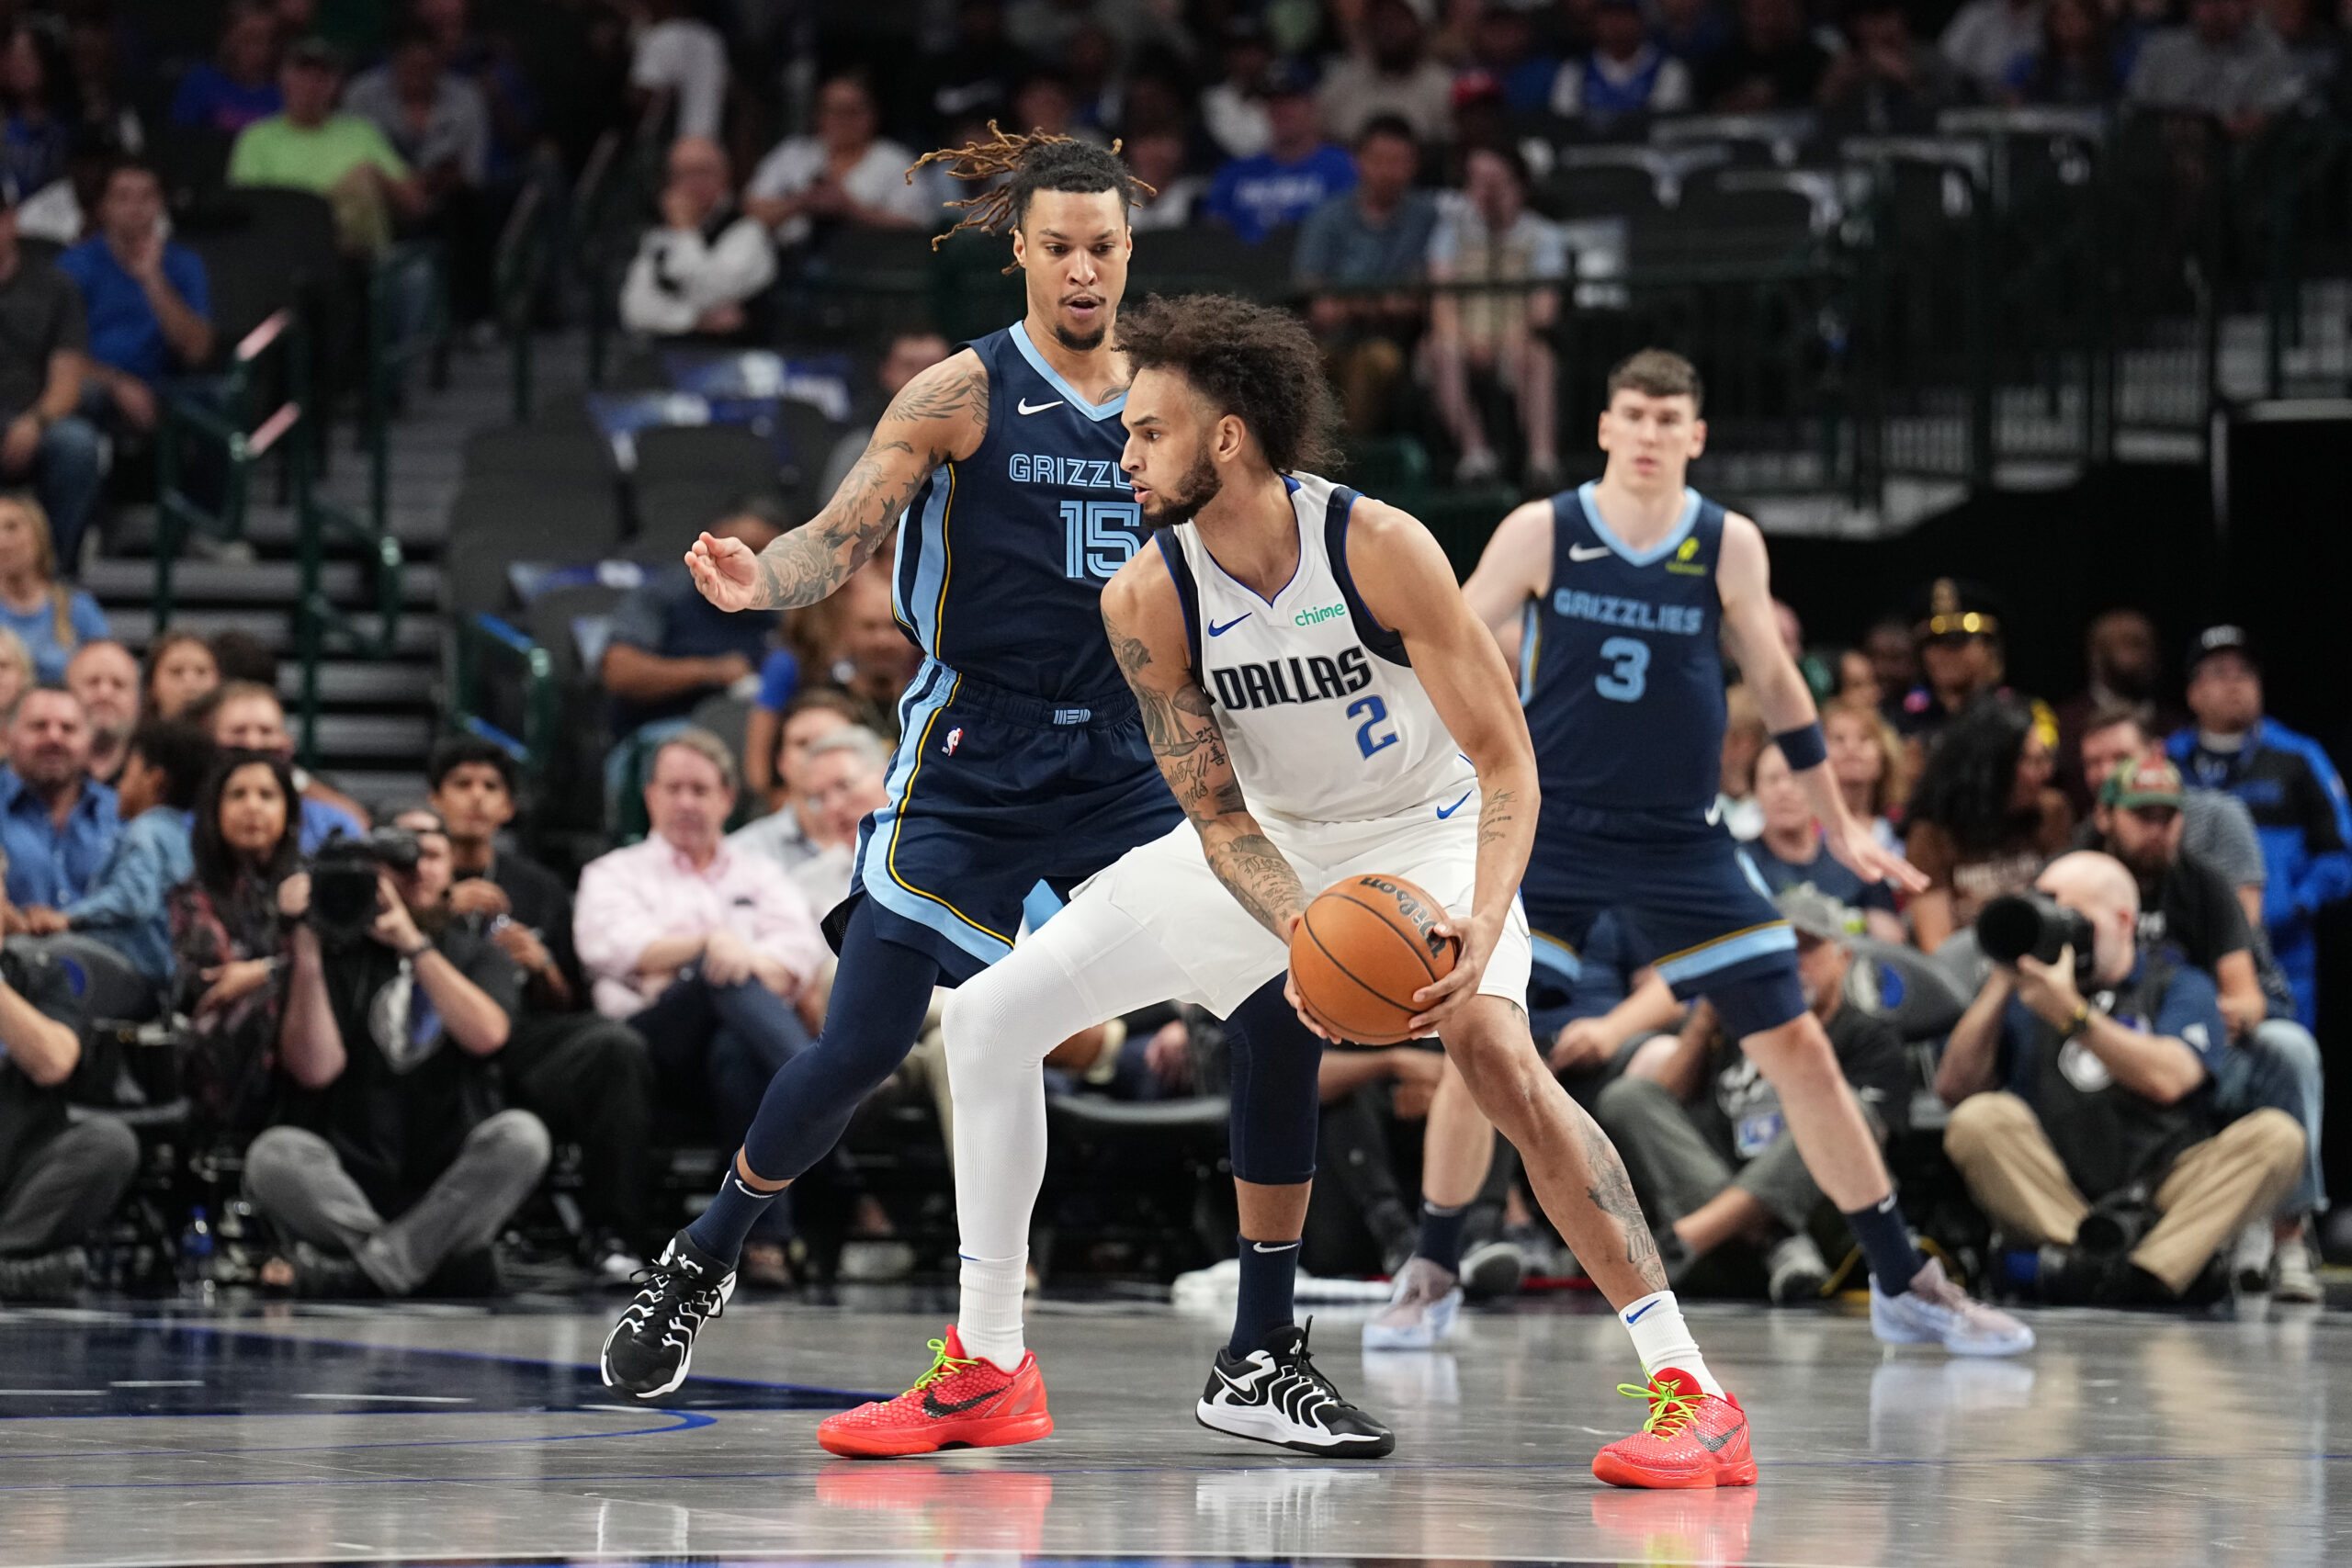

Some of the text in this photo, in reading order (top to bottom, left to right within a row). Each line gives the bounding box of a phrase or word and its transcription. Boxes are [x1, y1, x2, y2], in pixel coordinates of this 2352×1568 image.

[1009, 453, 1133, 490] GRIZZL
[1059, 500, 1141, 578] 15
[1295, 603, 1346, 626] chime
[1554, 587, 1703, 636] GRIZZLIES
[1210, 644, 1374, 711] DALLAS
[1594, 636, 1651, 703] 3
[1345, 694, 1400, 761] 2
